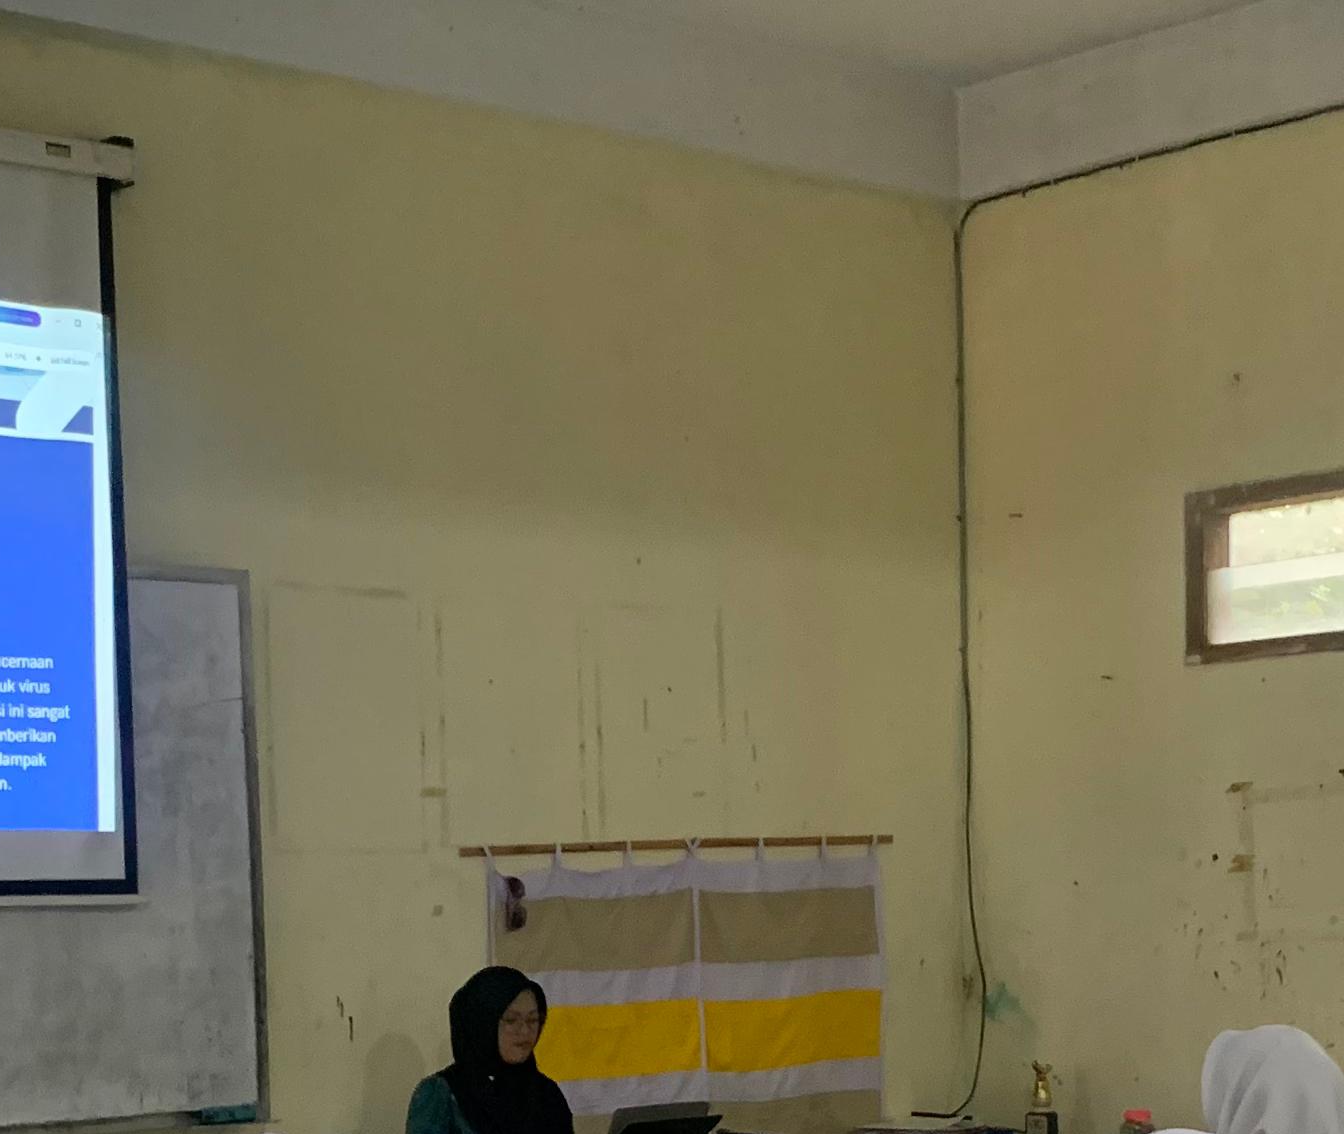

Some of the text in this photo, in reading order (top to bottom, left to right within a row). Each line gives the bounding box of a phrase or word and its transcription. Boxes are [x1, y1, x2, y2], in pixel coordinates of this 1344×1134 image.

[19, 678, 51, 695] virus
[8, 703, 25, 719] ini
[27, 704, 71, 723] sangat
